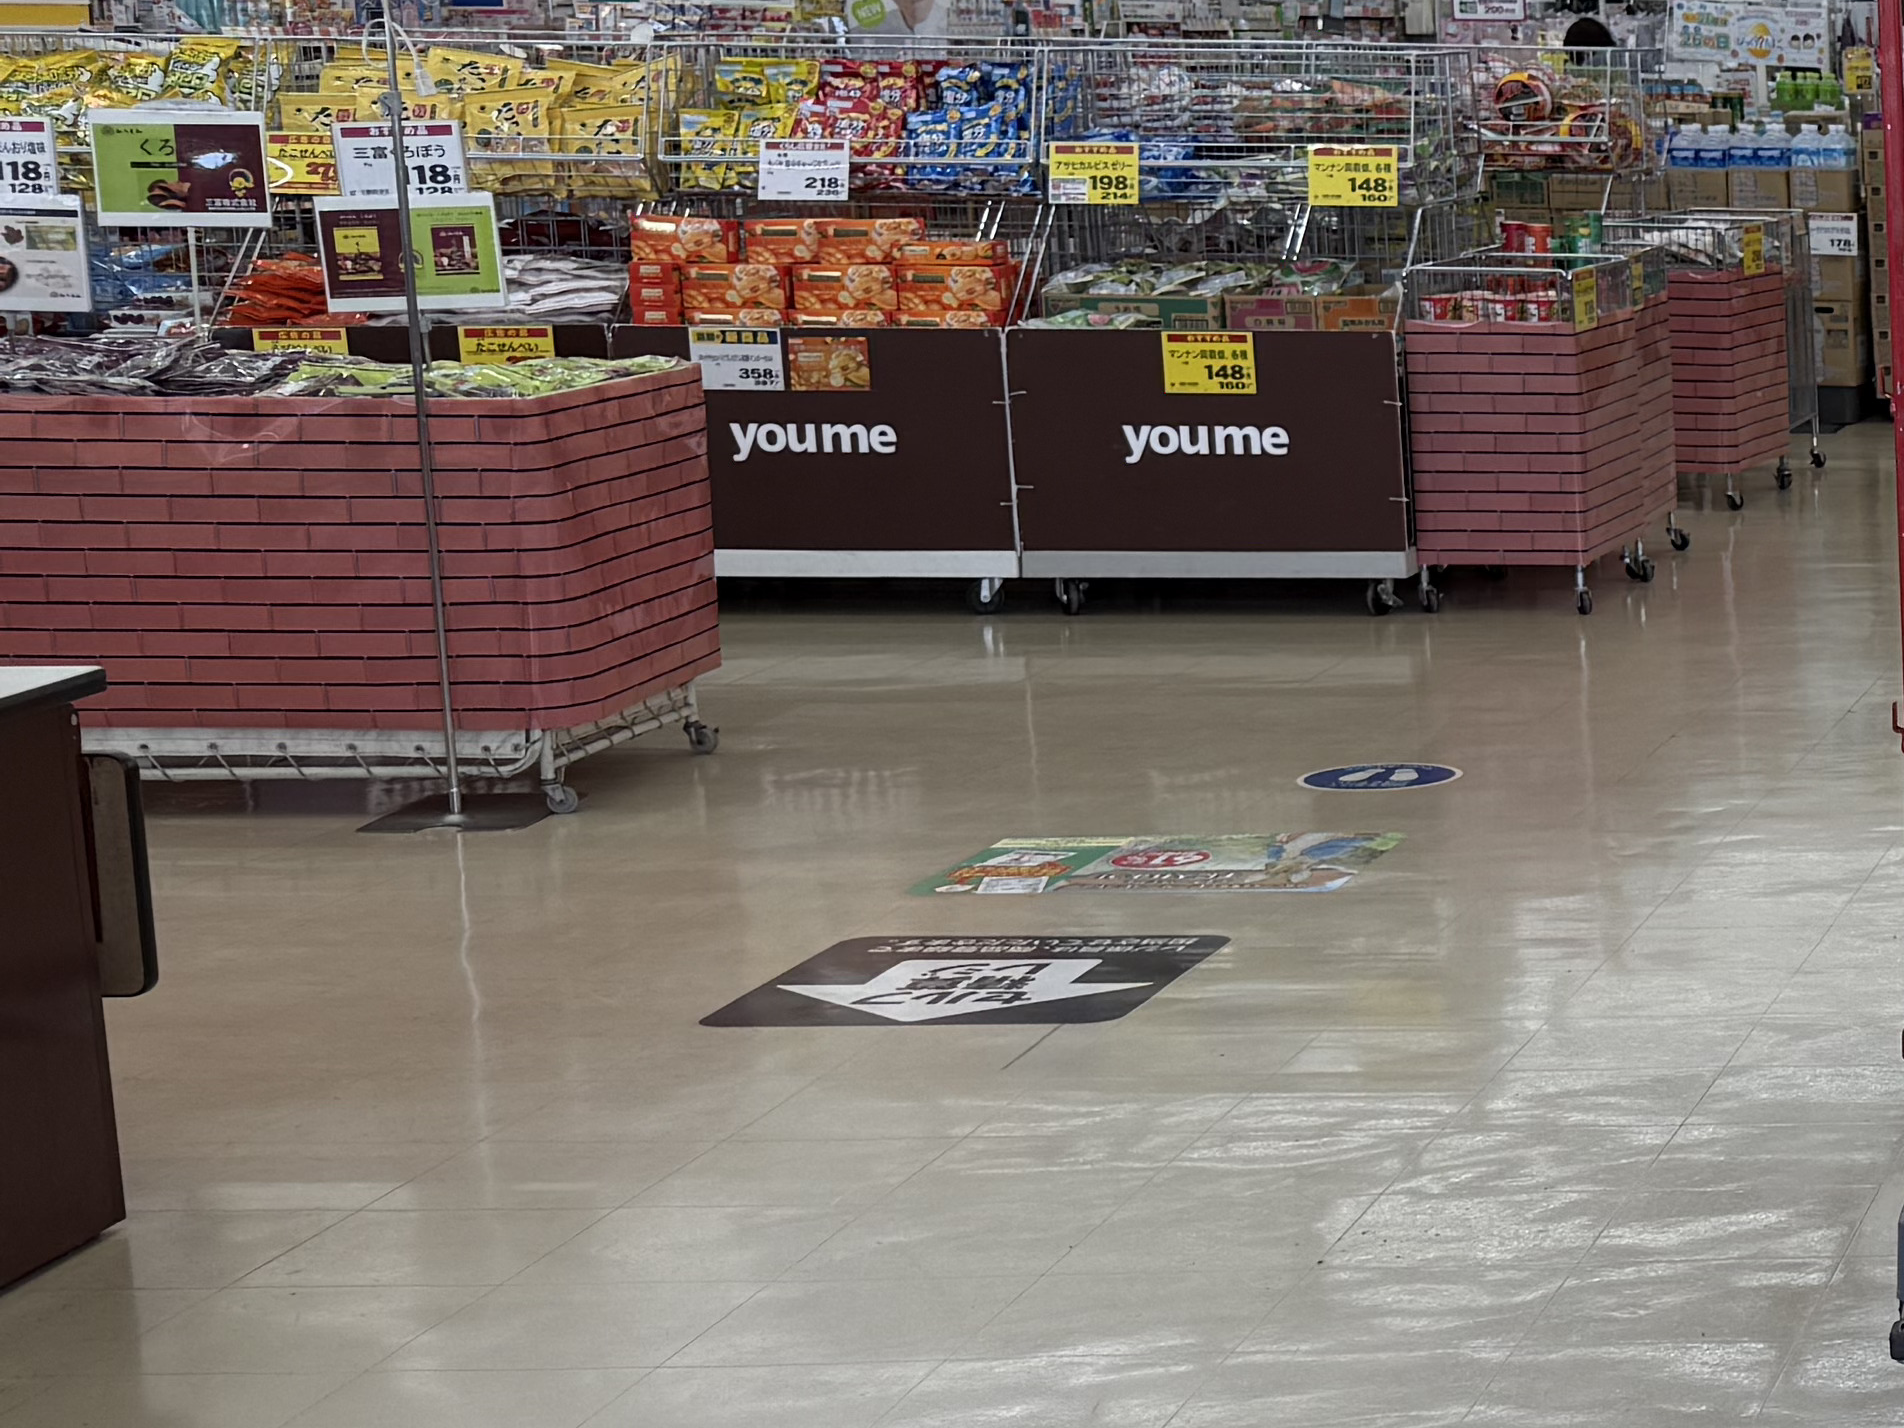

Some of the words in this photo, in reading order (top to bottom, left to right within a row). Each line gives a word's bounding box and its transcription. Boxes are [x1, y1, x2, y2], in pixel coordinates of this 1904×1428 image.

[804, 176, 839, 190] 218
[1088, 175, 1128, 191] 198
[1347, 177, 1387, 193] 148
[1203, 365, 1245, 381] 148
[730, 420, 898, 463] youme
[1122, 423, 1290, 465] youme
